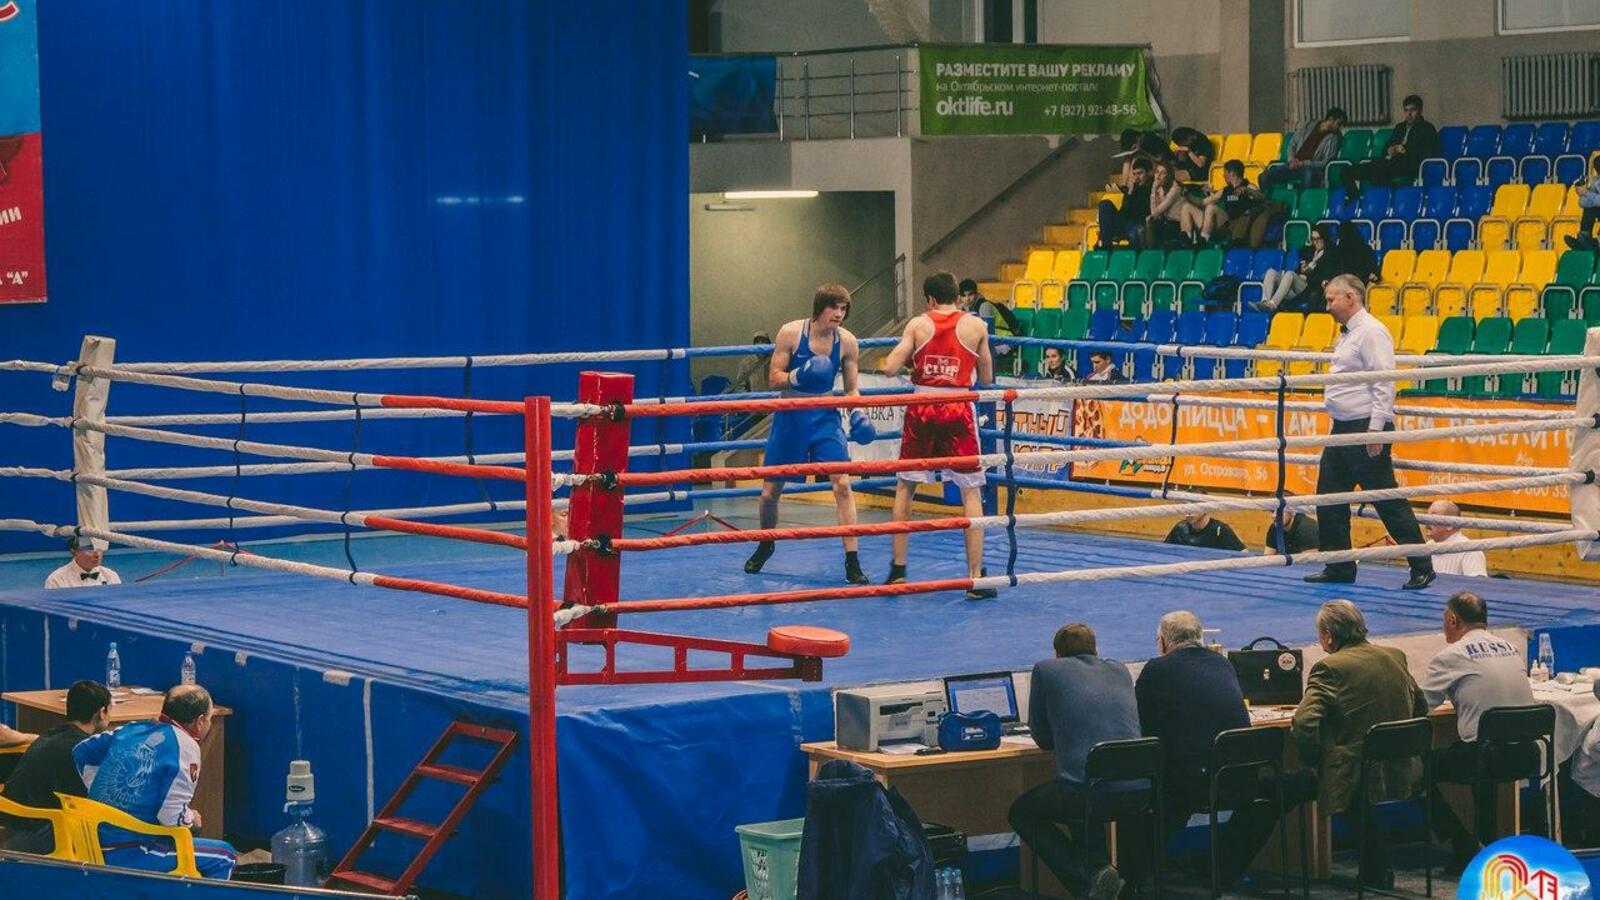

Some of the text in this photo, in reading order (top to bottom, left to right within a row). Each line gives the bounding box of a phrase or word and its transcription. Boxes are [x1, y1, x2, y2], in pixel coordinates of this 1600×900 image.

[936, 63, 1136, 77] РАЗМЕСТИТЕ ВАШУ РЕКЛАМУ
[935, 95, 1014, 116] oktlife.ru
[1043, 104, 1058, 116] +7
[1060, 103, 1085, 119] (927)
[1119, 402, 1172, 429] ДОДО
[1177, 404, 1248, 437] ПИЦЦА
[1278, 412, 1318, 437] АМ
